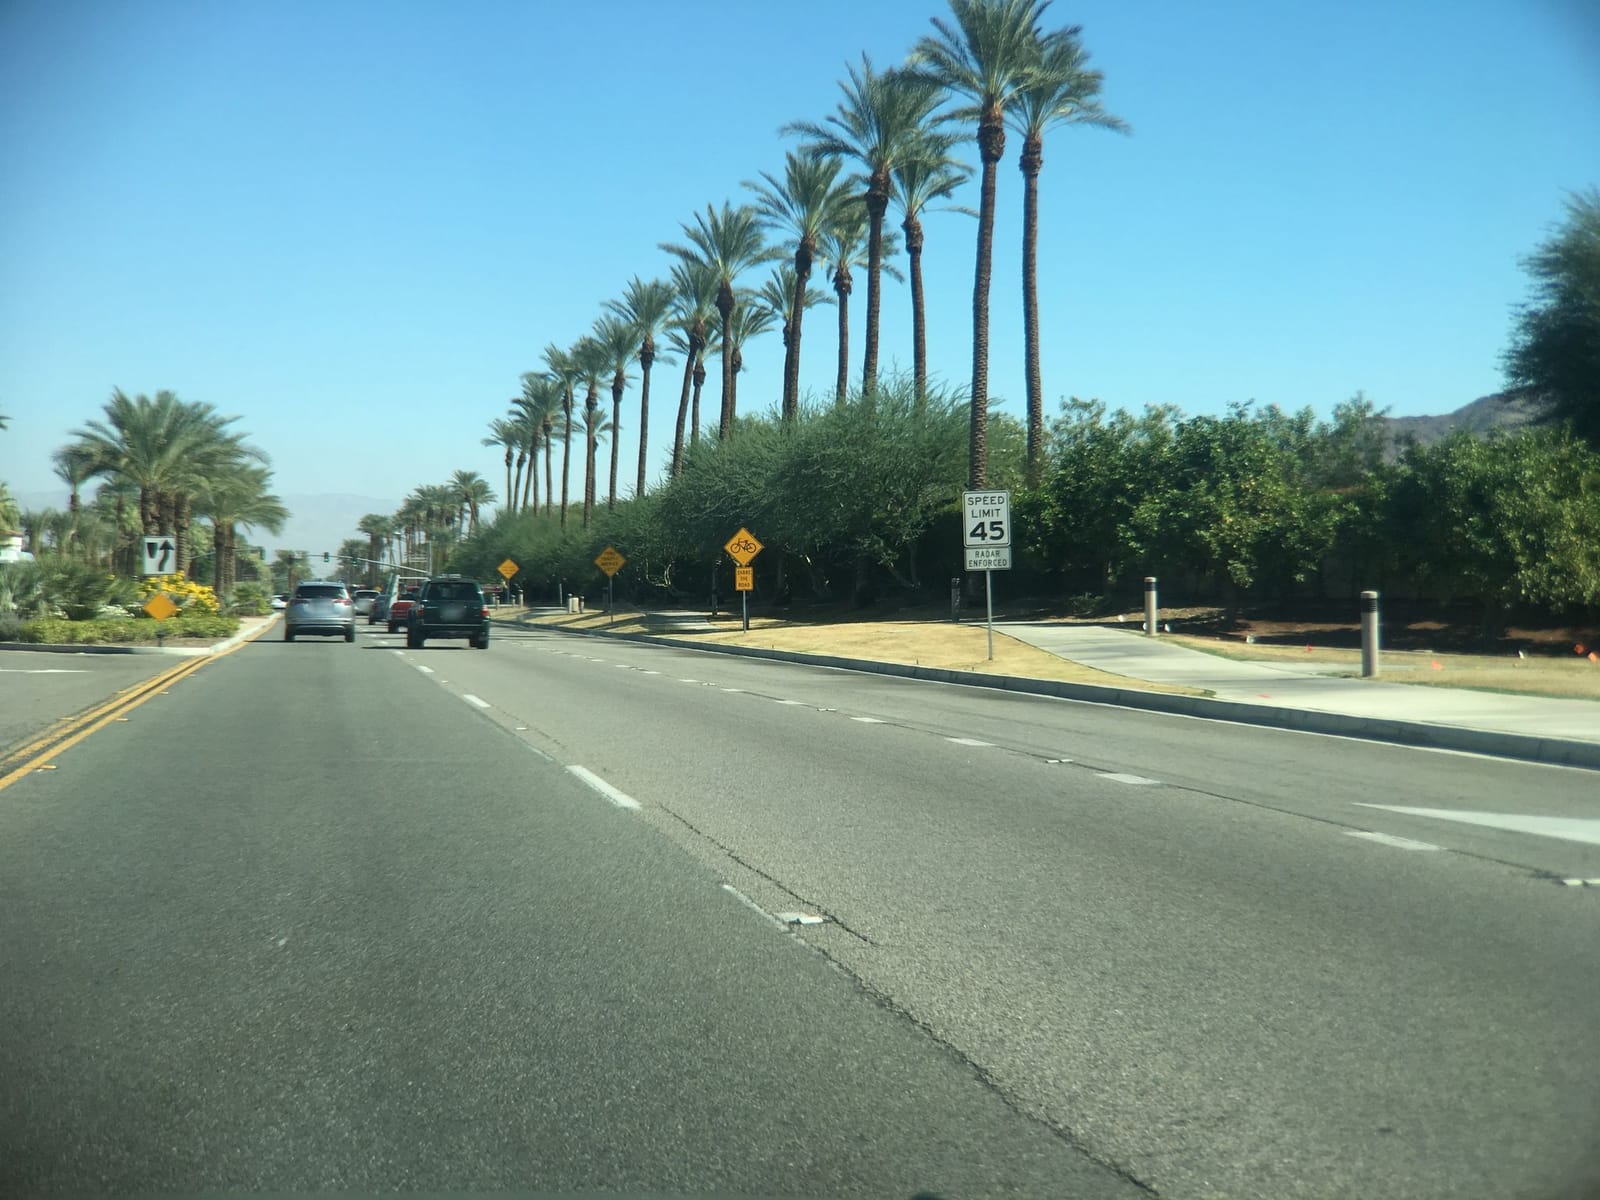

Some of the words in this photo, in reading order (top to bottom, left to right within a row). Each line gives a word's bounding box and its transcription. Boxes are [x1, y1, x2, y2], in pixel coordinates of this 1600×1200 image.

[968, 496, 1004, 506] SPEED
[972, 508, 1000, 518] LIMIT
[970, 521, 1004, 540] 45
[968, 559, 1008, 567] ENFORCED
